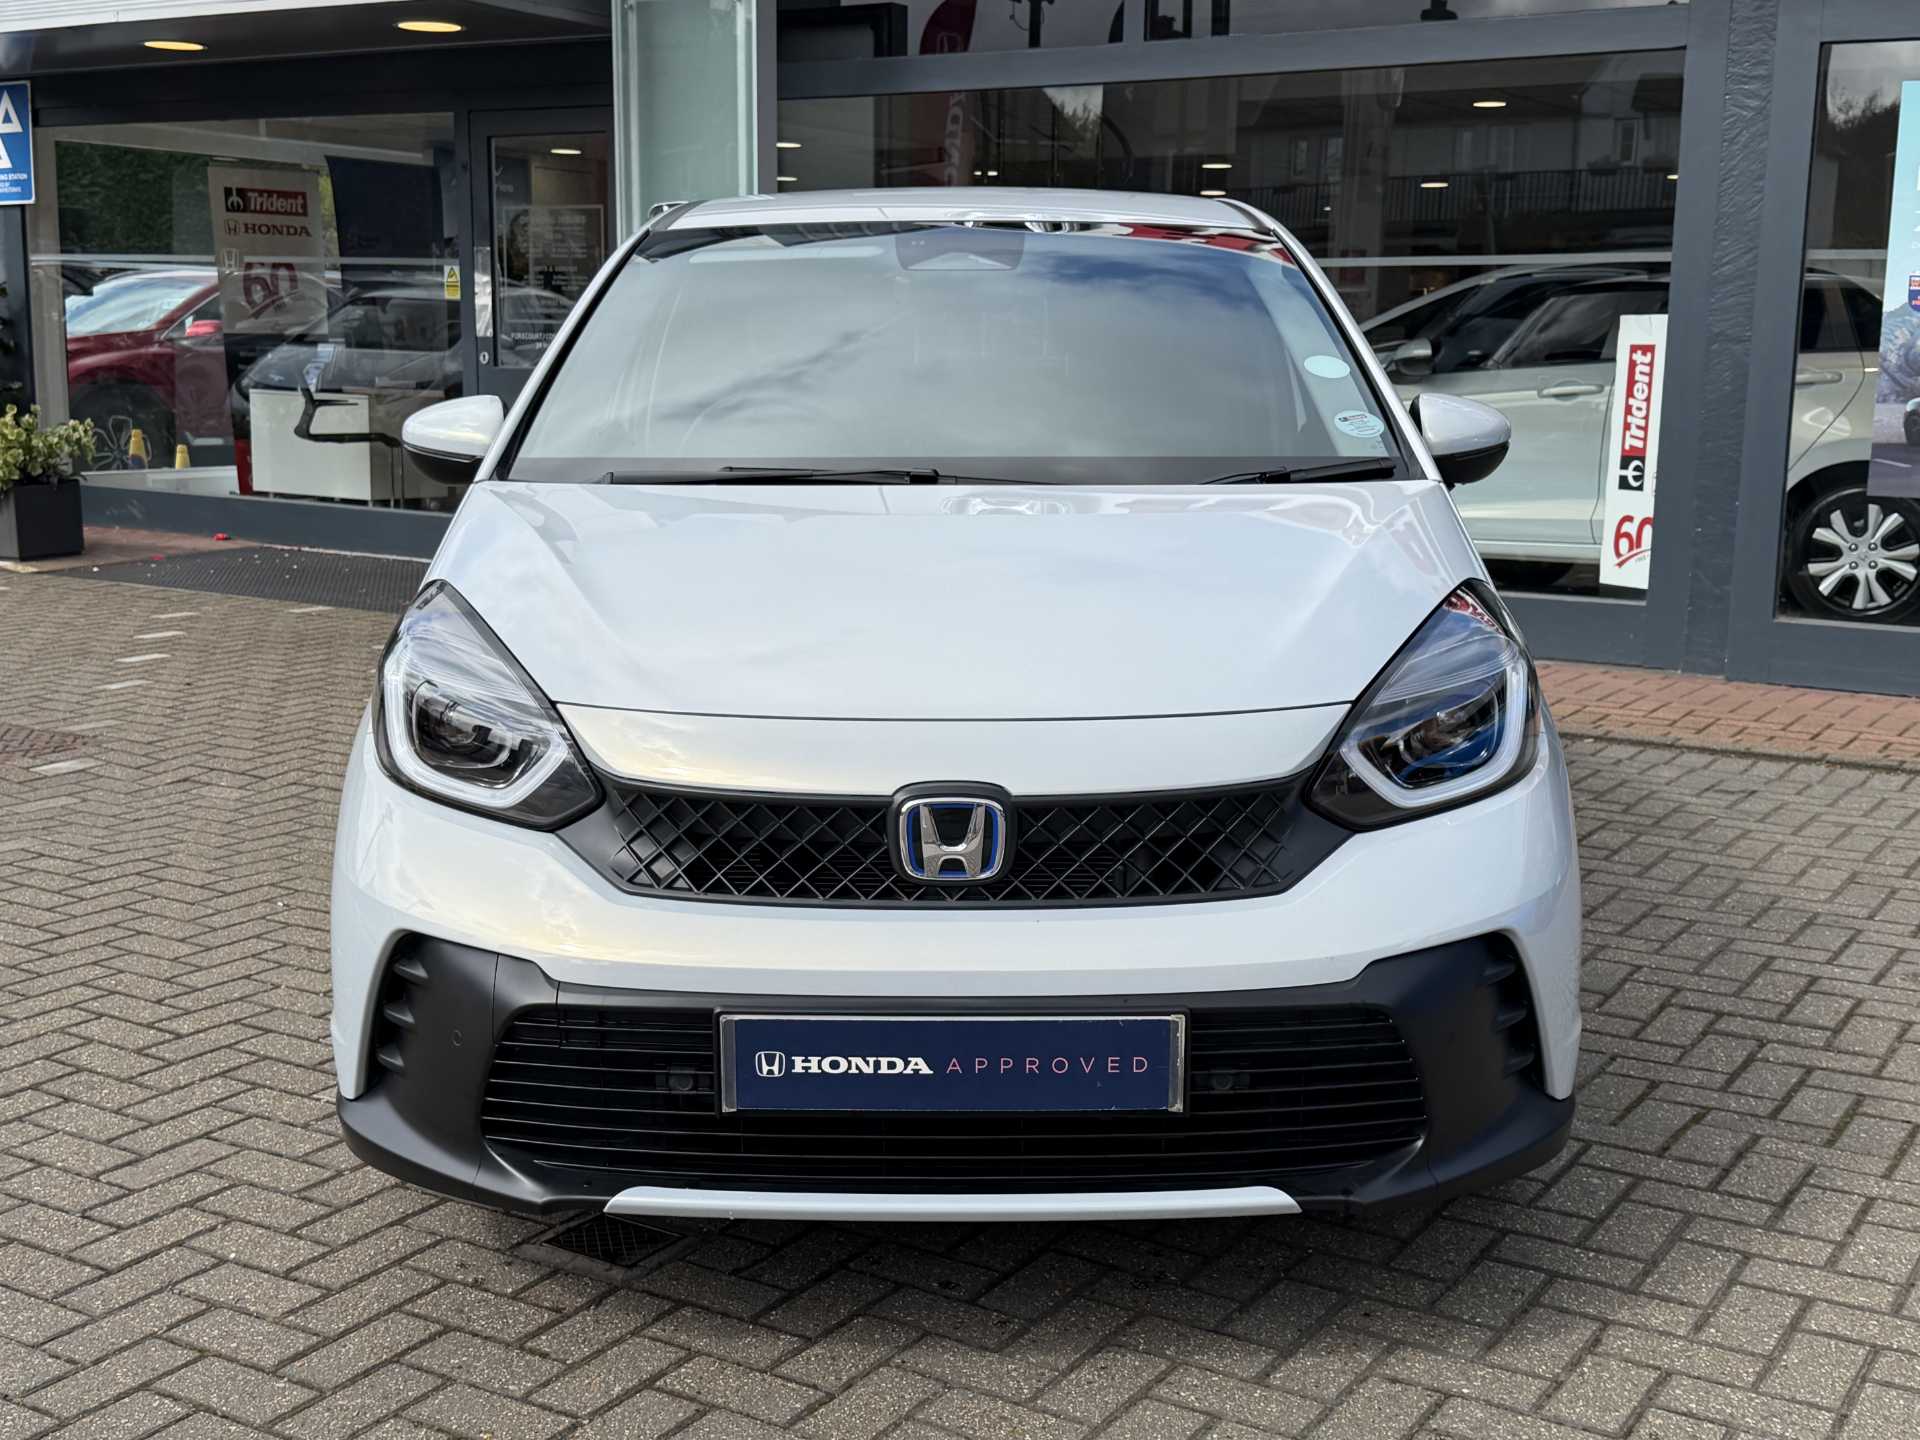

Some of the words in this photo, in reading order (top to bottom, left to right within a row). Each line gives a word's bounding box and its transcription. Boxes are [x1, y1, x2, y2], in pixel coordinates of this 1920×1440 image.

[247, 191, 305, 214] Trident
[243, 222, 312, 238] HONDA
[1625, 349, 1653, 452] Trident
[790, 1055, 934, 1075] HONDA
[945, 1056, 1149, 1075] APPROVED
